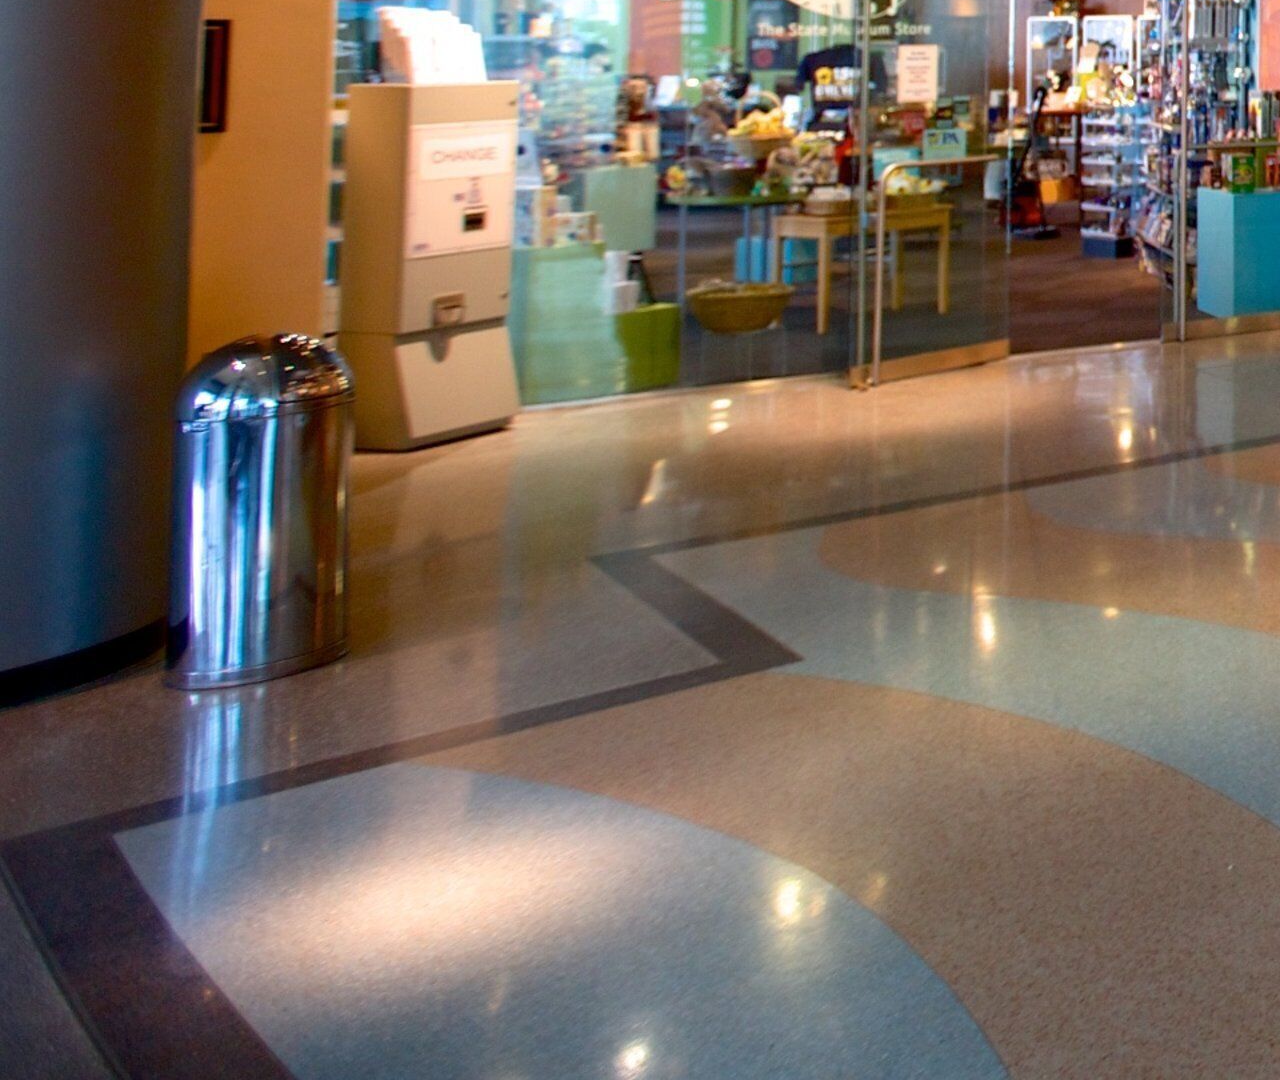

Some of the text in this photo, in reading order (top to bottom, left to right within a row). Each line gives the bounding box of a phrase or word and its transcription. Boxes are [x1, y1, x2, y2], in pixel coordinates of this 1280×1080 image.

[757, 23, 785, 36] The
[788, 23, 828, 36] State
[895, 22, 932, 36] Store
[431, 147, 498, 164] CHANGE
